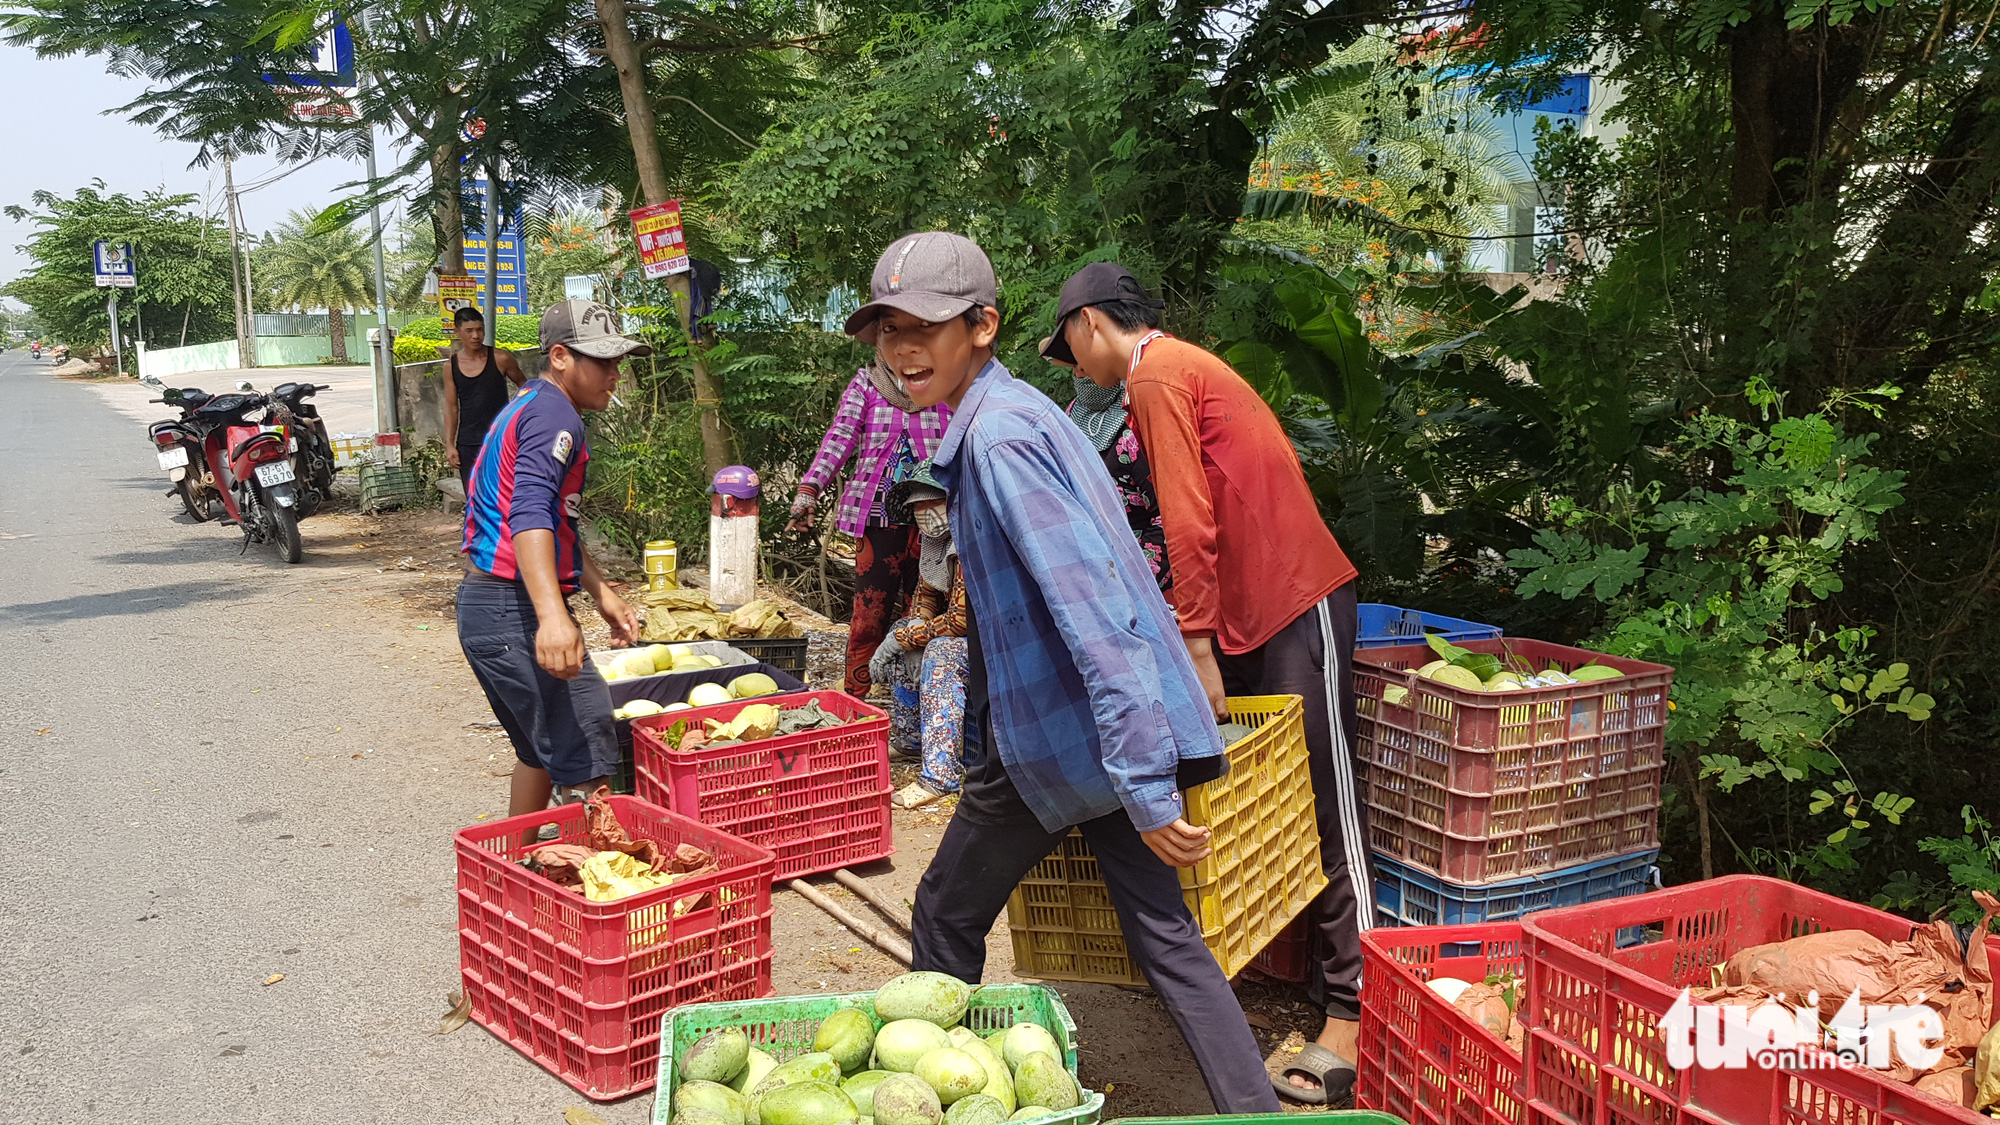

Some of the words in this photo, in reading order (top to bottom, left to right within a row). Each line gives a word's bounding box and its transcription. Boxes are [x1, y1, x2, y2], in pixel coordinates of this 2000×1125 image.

[639, 234, 655, 252] WIFI
[668, 260, 678, 270] 620
[678, 257, 688, 267] 222
[262, 464, 284, 476] 67-G1
[262, 470, 293, 485] 569.70
